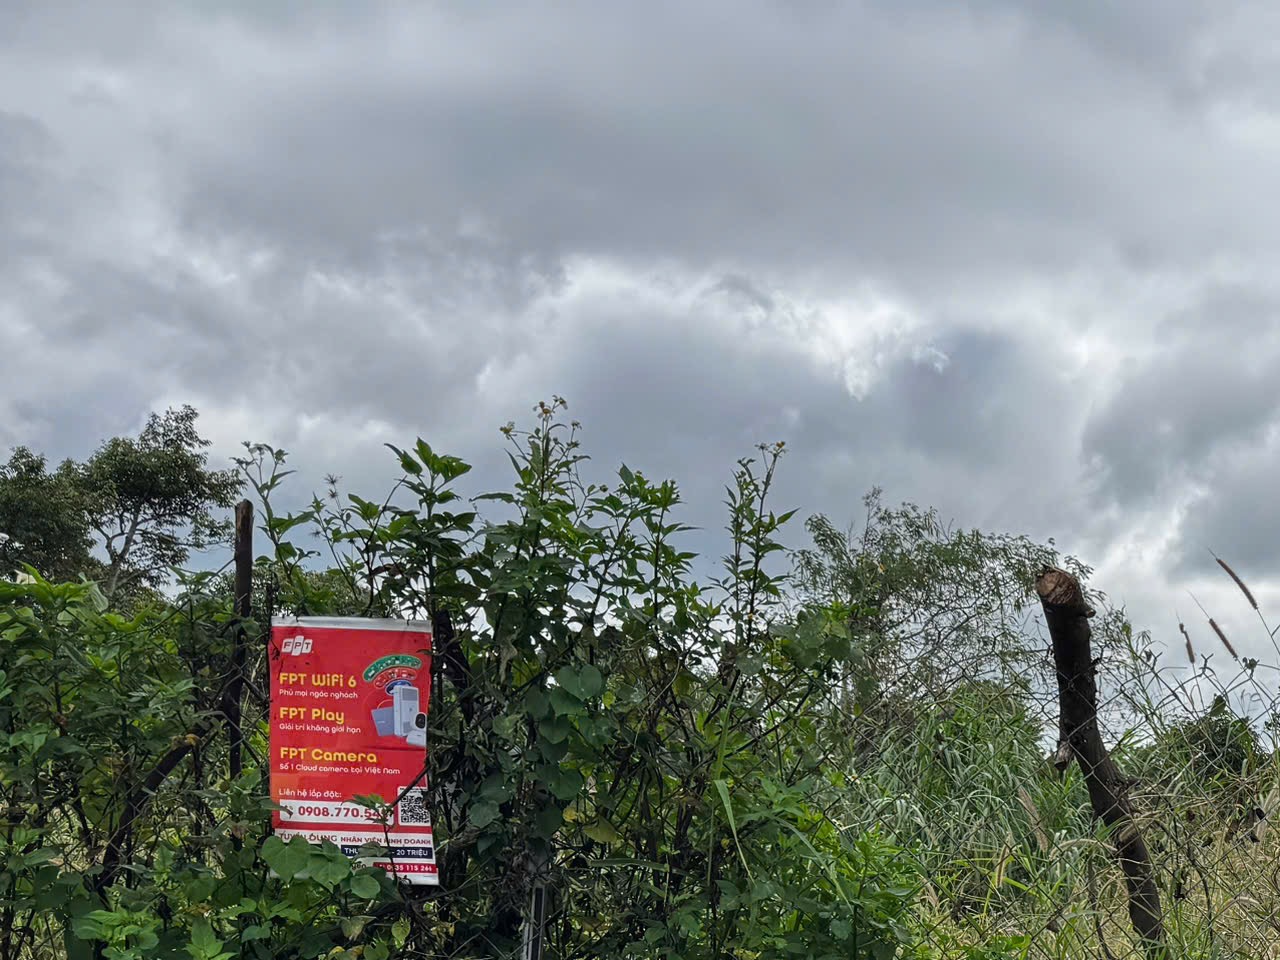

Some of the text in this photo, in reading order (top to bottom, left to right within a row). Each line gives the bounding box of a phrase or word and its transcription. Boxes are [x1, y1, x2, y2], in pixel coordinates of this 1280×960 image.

[282, 636, 313, 655] FPT
[280, 673, 357, 688] FPT Wifi 6
[279, 688, 294, 696] Phủ
[294, 689, 308, 697] mọi
[309, 690, 329, 698] ngóc
[280, 706, 344, 725] FPT Play
[279, 723, 294, 731] Giải
[306, 724, 330, 733] không
[331, 725, 345, 733] giới
[346, 726, 361, 734] hạn
[280, 747, 377, 763] FPT Camera
[279, 762, 289, 770] Số
[350, 766, 363, 774] tại
[364, 767, 381, 775] Việt
[278, 788, 342, 799] Liên hệ lắp đặt:
[298, 805, 385, 818] 0908.770.54
[406, 849, 428, 857] TRIỆU
